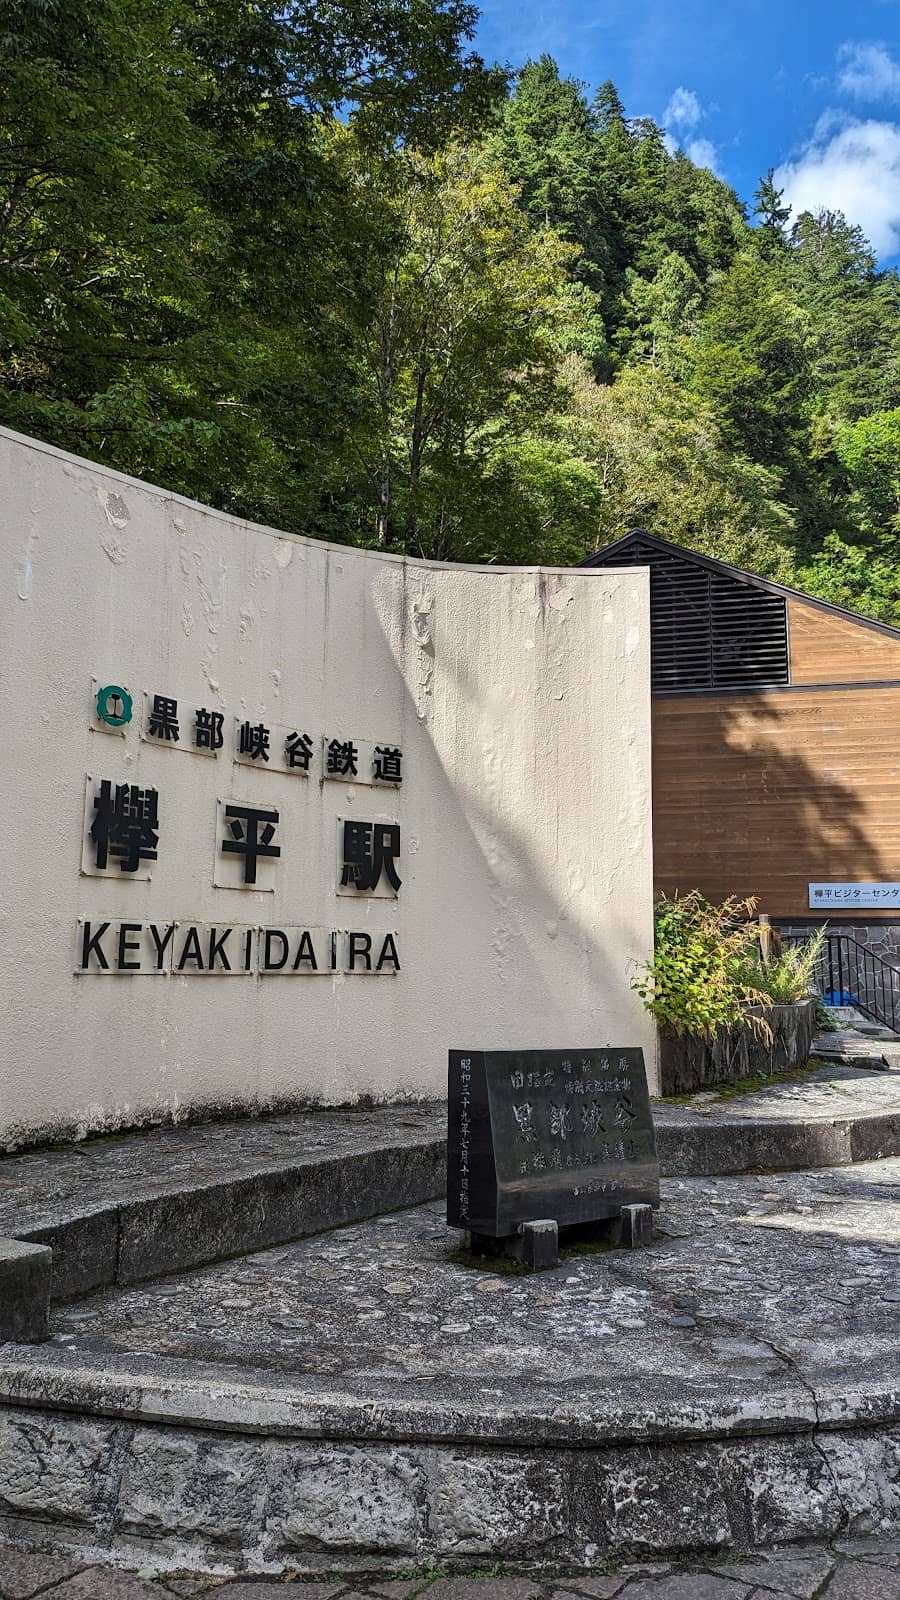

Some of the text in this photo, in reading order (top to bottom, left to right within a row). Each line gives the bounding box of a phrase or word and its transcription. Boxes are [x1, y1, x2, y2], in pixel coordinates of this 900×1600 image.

[148, 694, 403, 782] 黒部峡谷鉄道
[91, 779, 402, 893] 欅平駅
[81, 921, 401, 971] KEYAKIDAIRA
